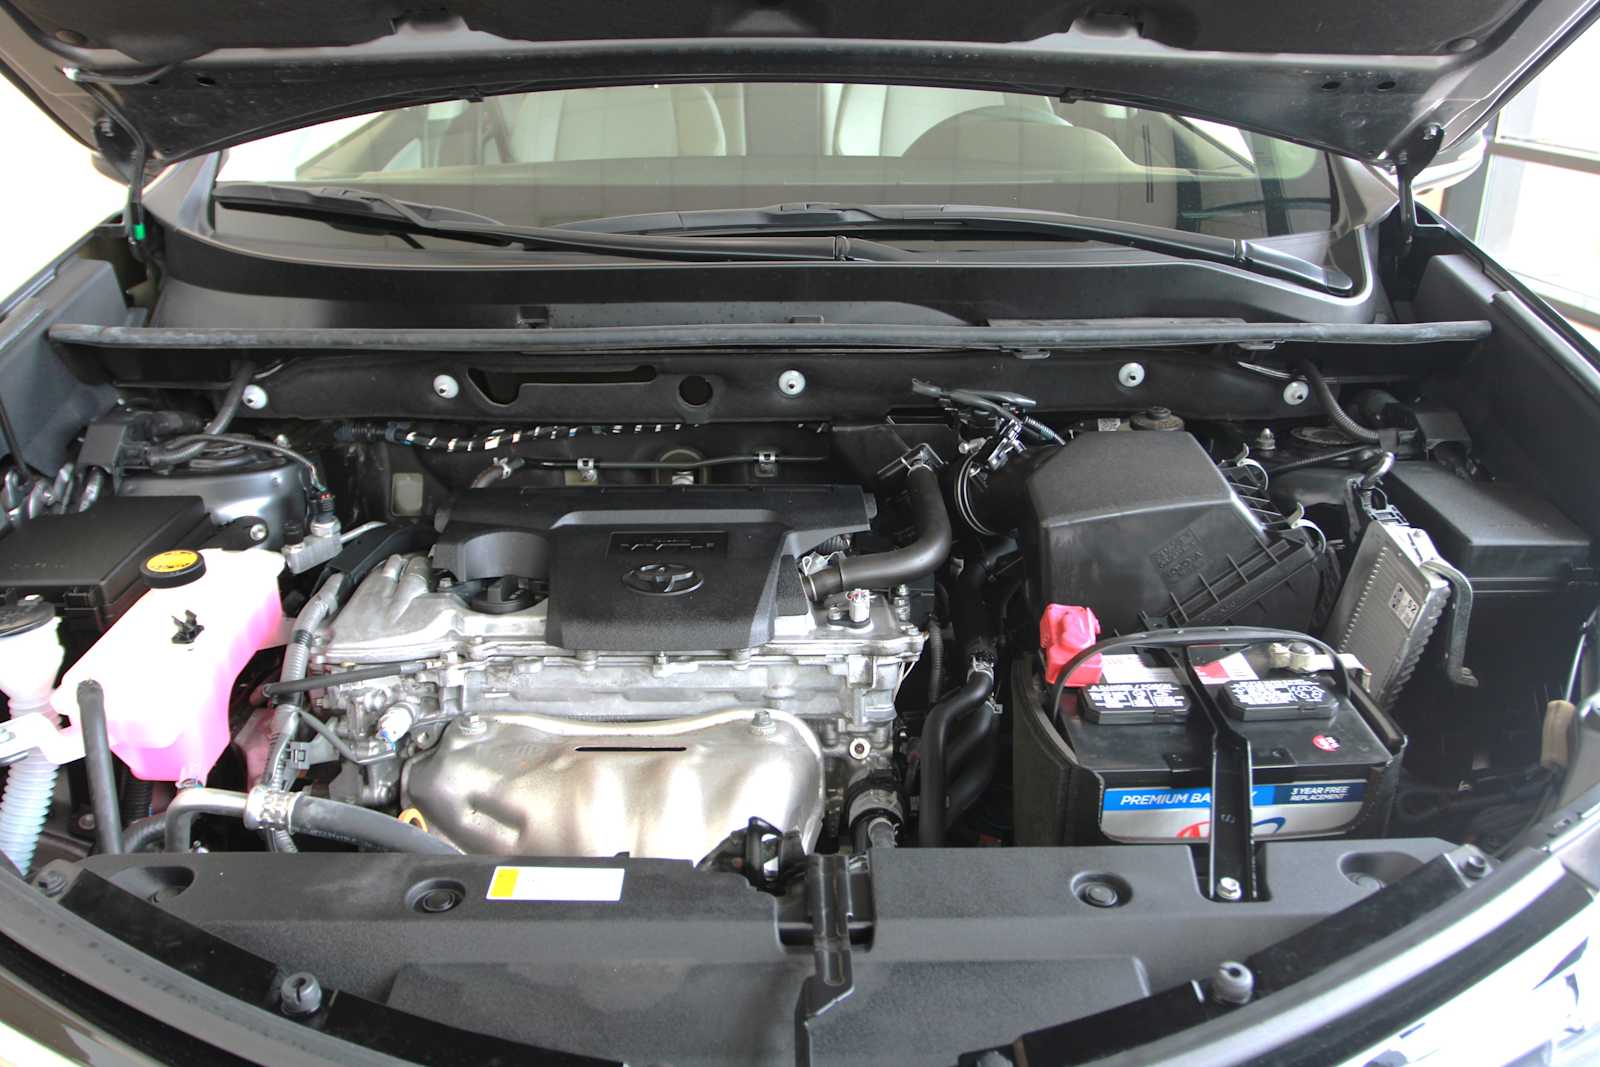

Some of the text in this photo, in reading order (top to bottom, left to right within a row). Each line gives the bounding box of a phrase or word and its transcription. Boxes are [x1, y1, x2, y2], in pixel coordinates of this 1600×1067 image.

[1300, 786, 1324, 795] YEAR
[1325, 785, 1350, 794] FREE
[1120, 794, 1187, 805] PREMIUM
